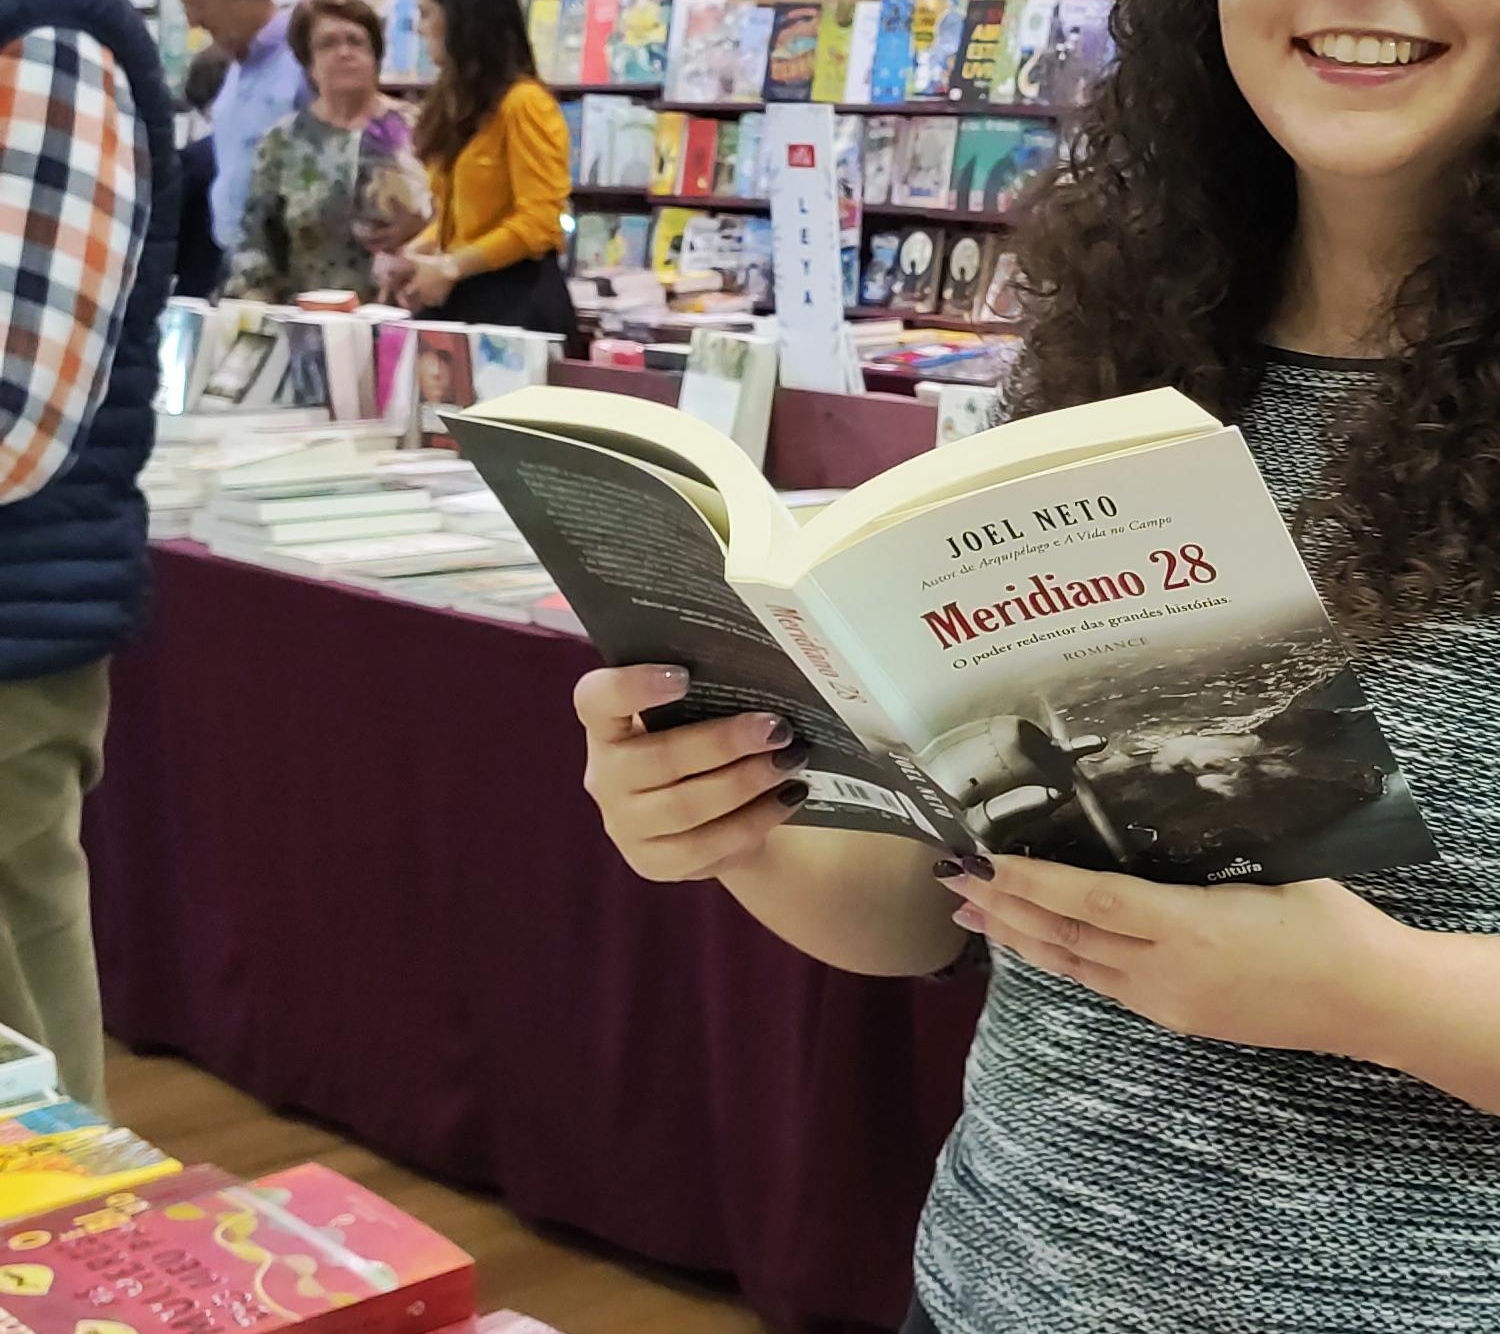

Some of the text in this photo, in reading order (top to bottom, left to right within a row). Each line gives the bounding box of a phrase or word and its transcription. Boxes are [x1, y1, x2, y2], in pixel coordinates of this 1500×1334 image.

[921, 516, 1172, 591] Autor de Arquipélago e A Vida no Campo
[946, 495, 1118, 559] JOEL NETO
[921, 543, 1217, 650] Meridiano 28
[952, 595, 1232, 670] O poder redentor das grandes histórias.
[767, 602, 867, 704] Meridiano 28
[1063, 636, 1150, 662] ROMANCE
[888, 751, 955, 820] JOEL NETO
[1207, 862, 1262, 881] cultura
